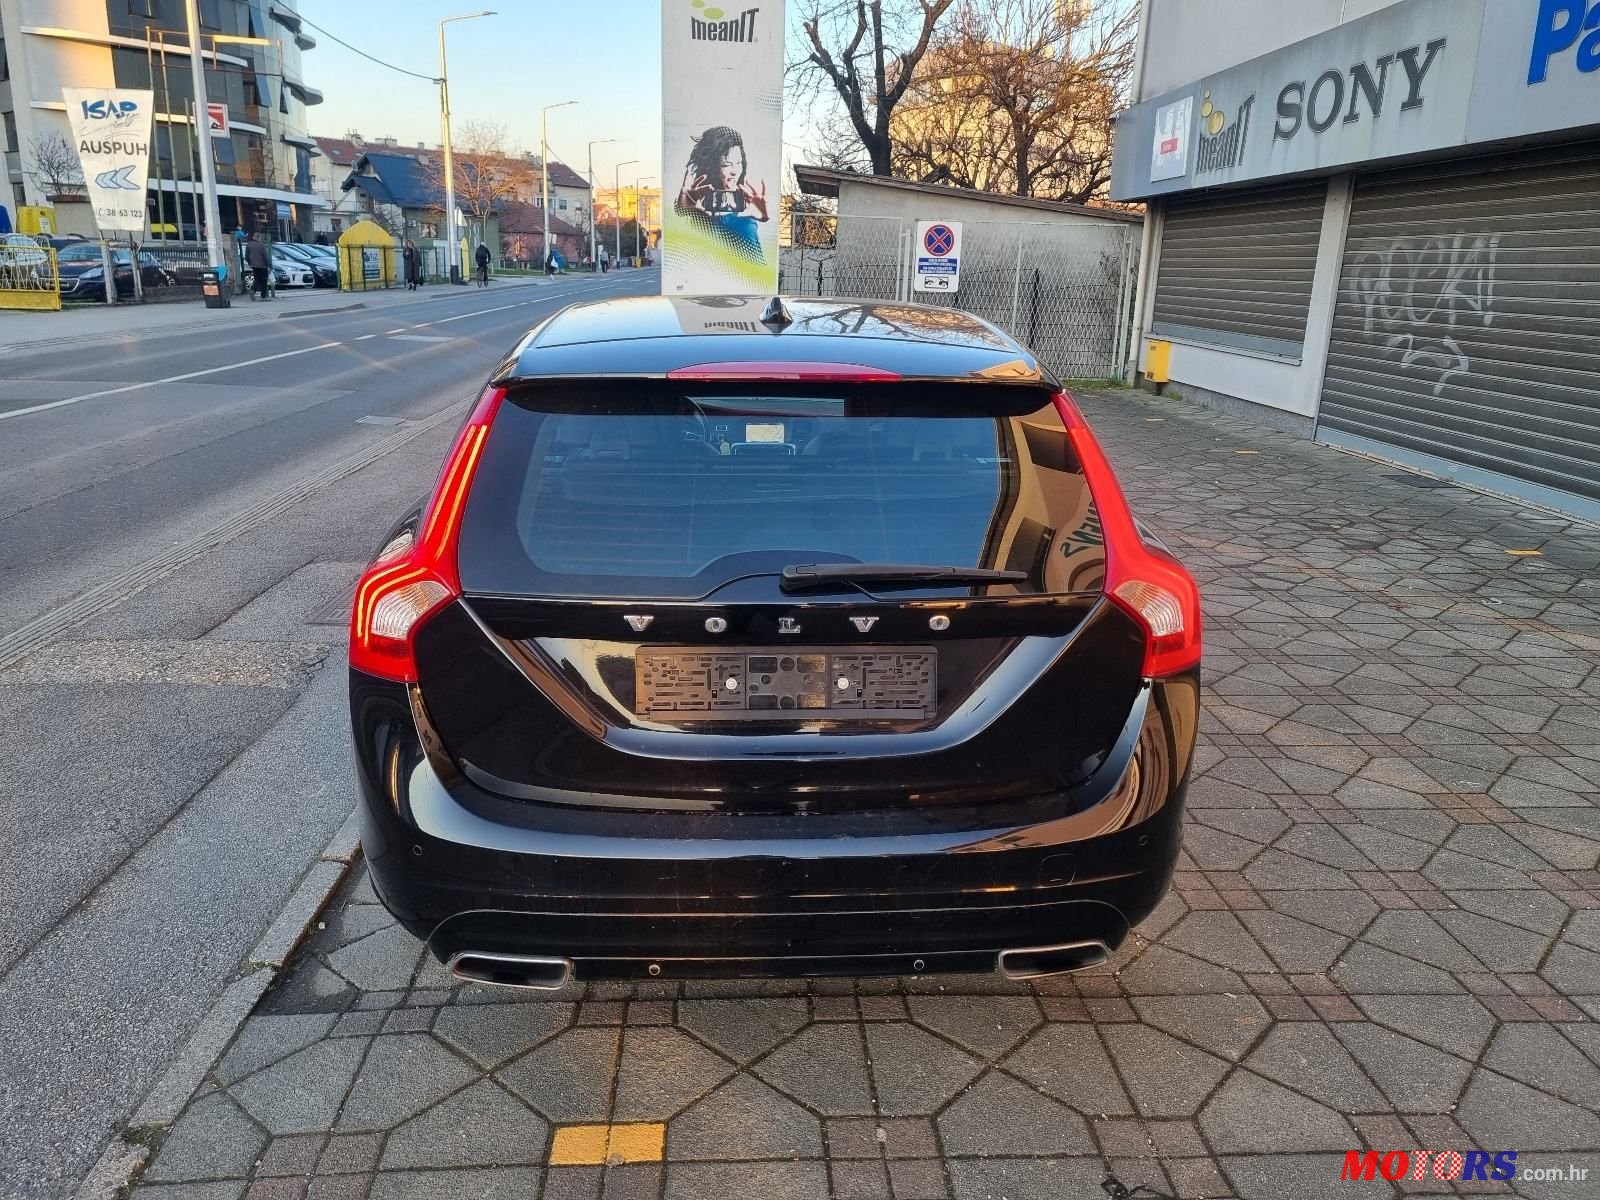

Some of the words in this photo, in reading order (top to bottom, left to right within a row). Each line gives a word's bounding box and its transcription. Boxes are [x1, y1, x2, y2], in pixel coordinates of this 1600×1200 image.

[691, 8, 760, 43] meanIT
[1272, 35, 1448, 141] SONY
[1196, 92, 1256, 175] meanIT
[79, 140, 148, 157] AUSPUH
[130, 209, 143, 218] 123
[623, 614, 951, 634] VOLVO
